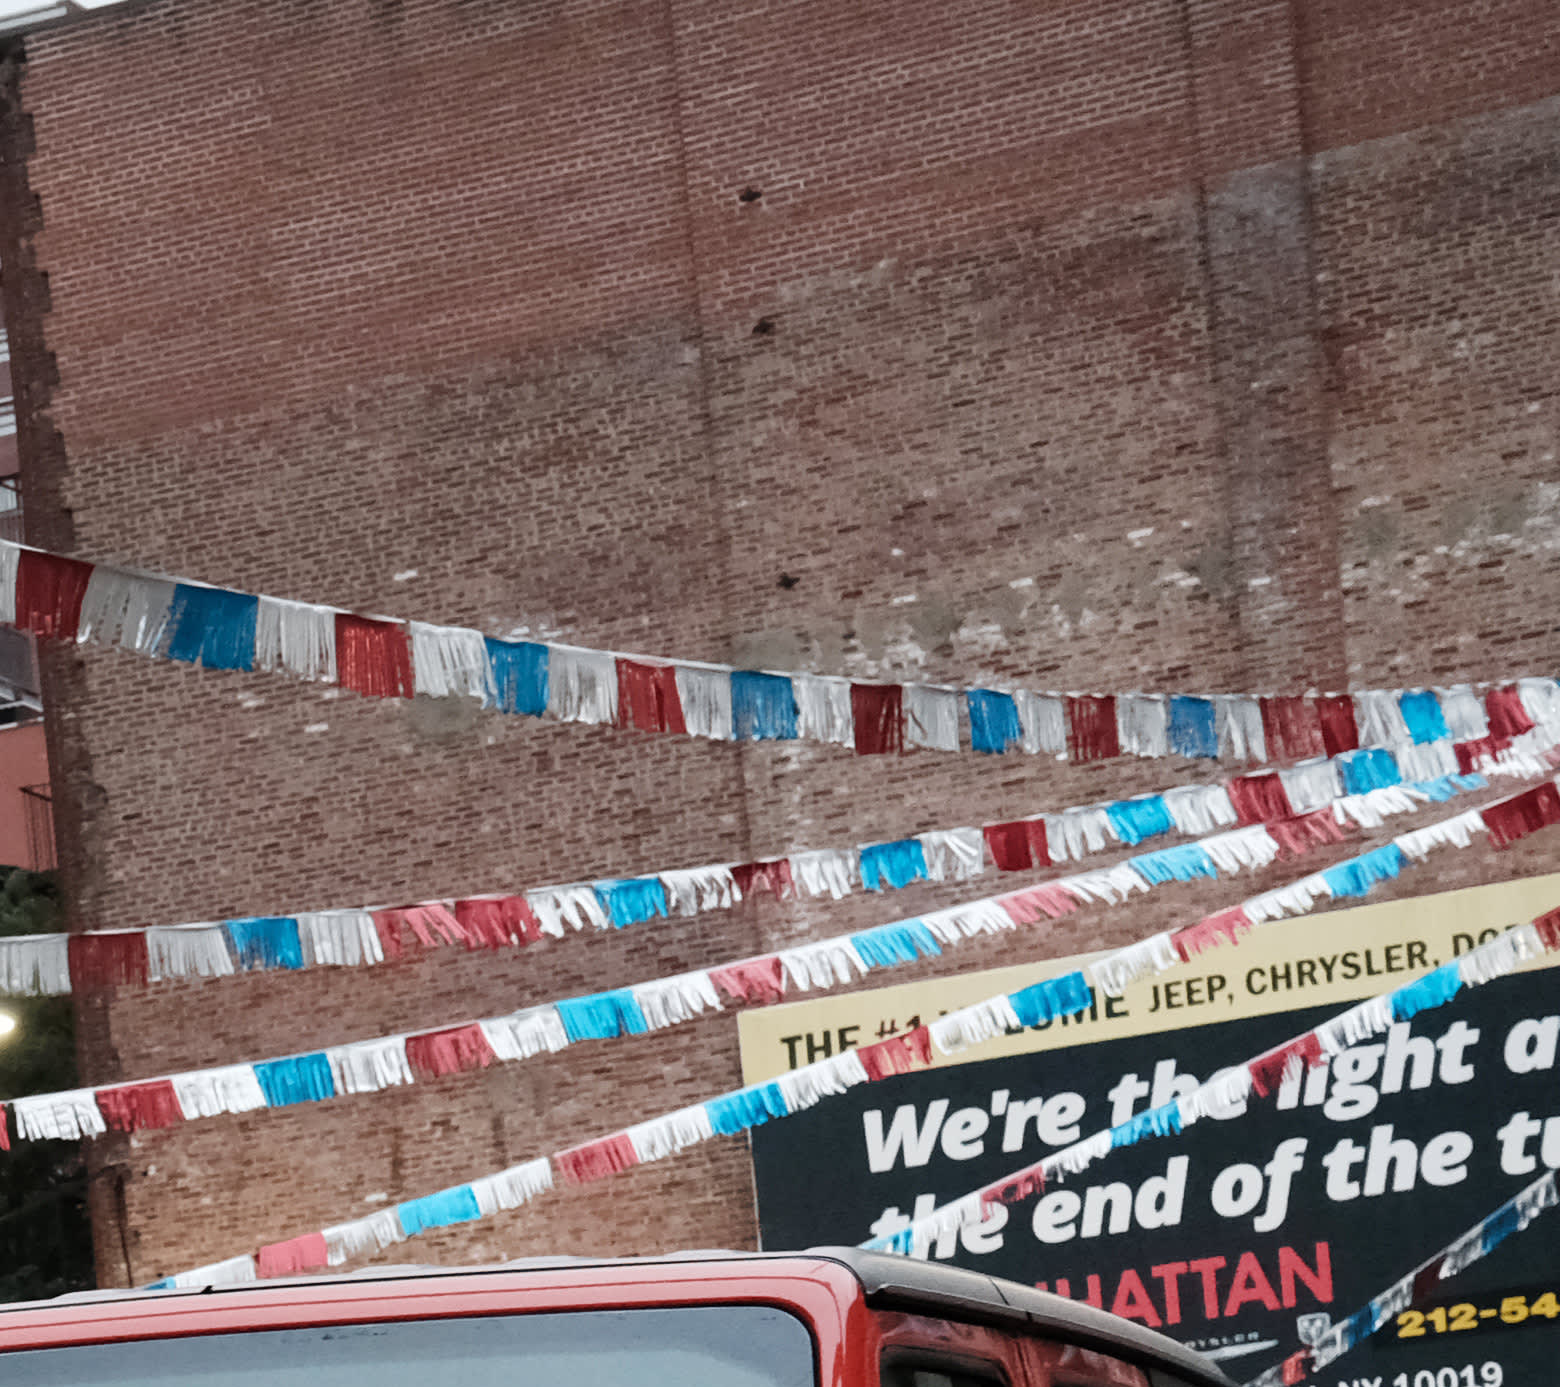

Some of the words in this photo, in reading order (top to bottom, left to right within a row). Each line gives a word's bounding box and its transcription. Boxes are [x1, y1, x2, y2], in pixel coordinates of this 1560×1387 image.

[1147, 972, 1235, 1013] JEEP,
[1244, 940, 1441, 994] CHRYSLER,
[862, 1088, 1086, 1174] We're
[1031, 1154, 1189, 1244] end
[1210, 1136, 1309, 1233] of
[1321, 1123, 1474, 1202] the
[1034, 1241, 1334, 1330] HATTAN
[1395, 1290, 1560, 1340] 212-54
